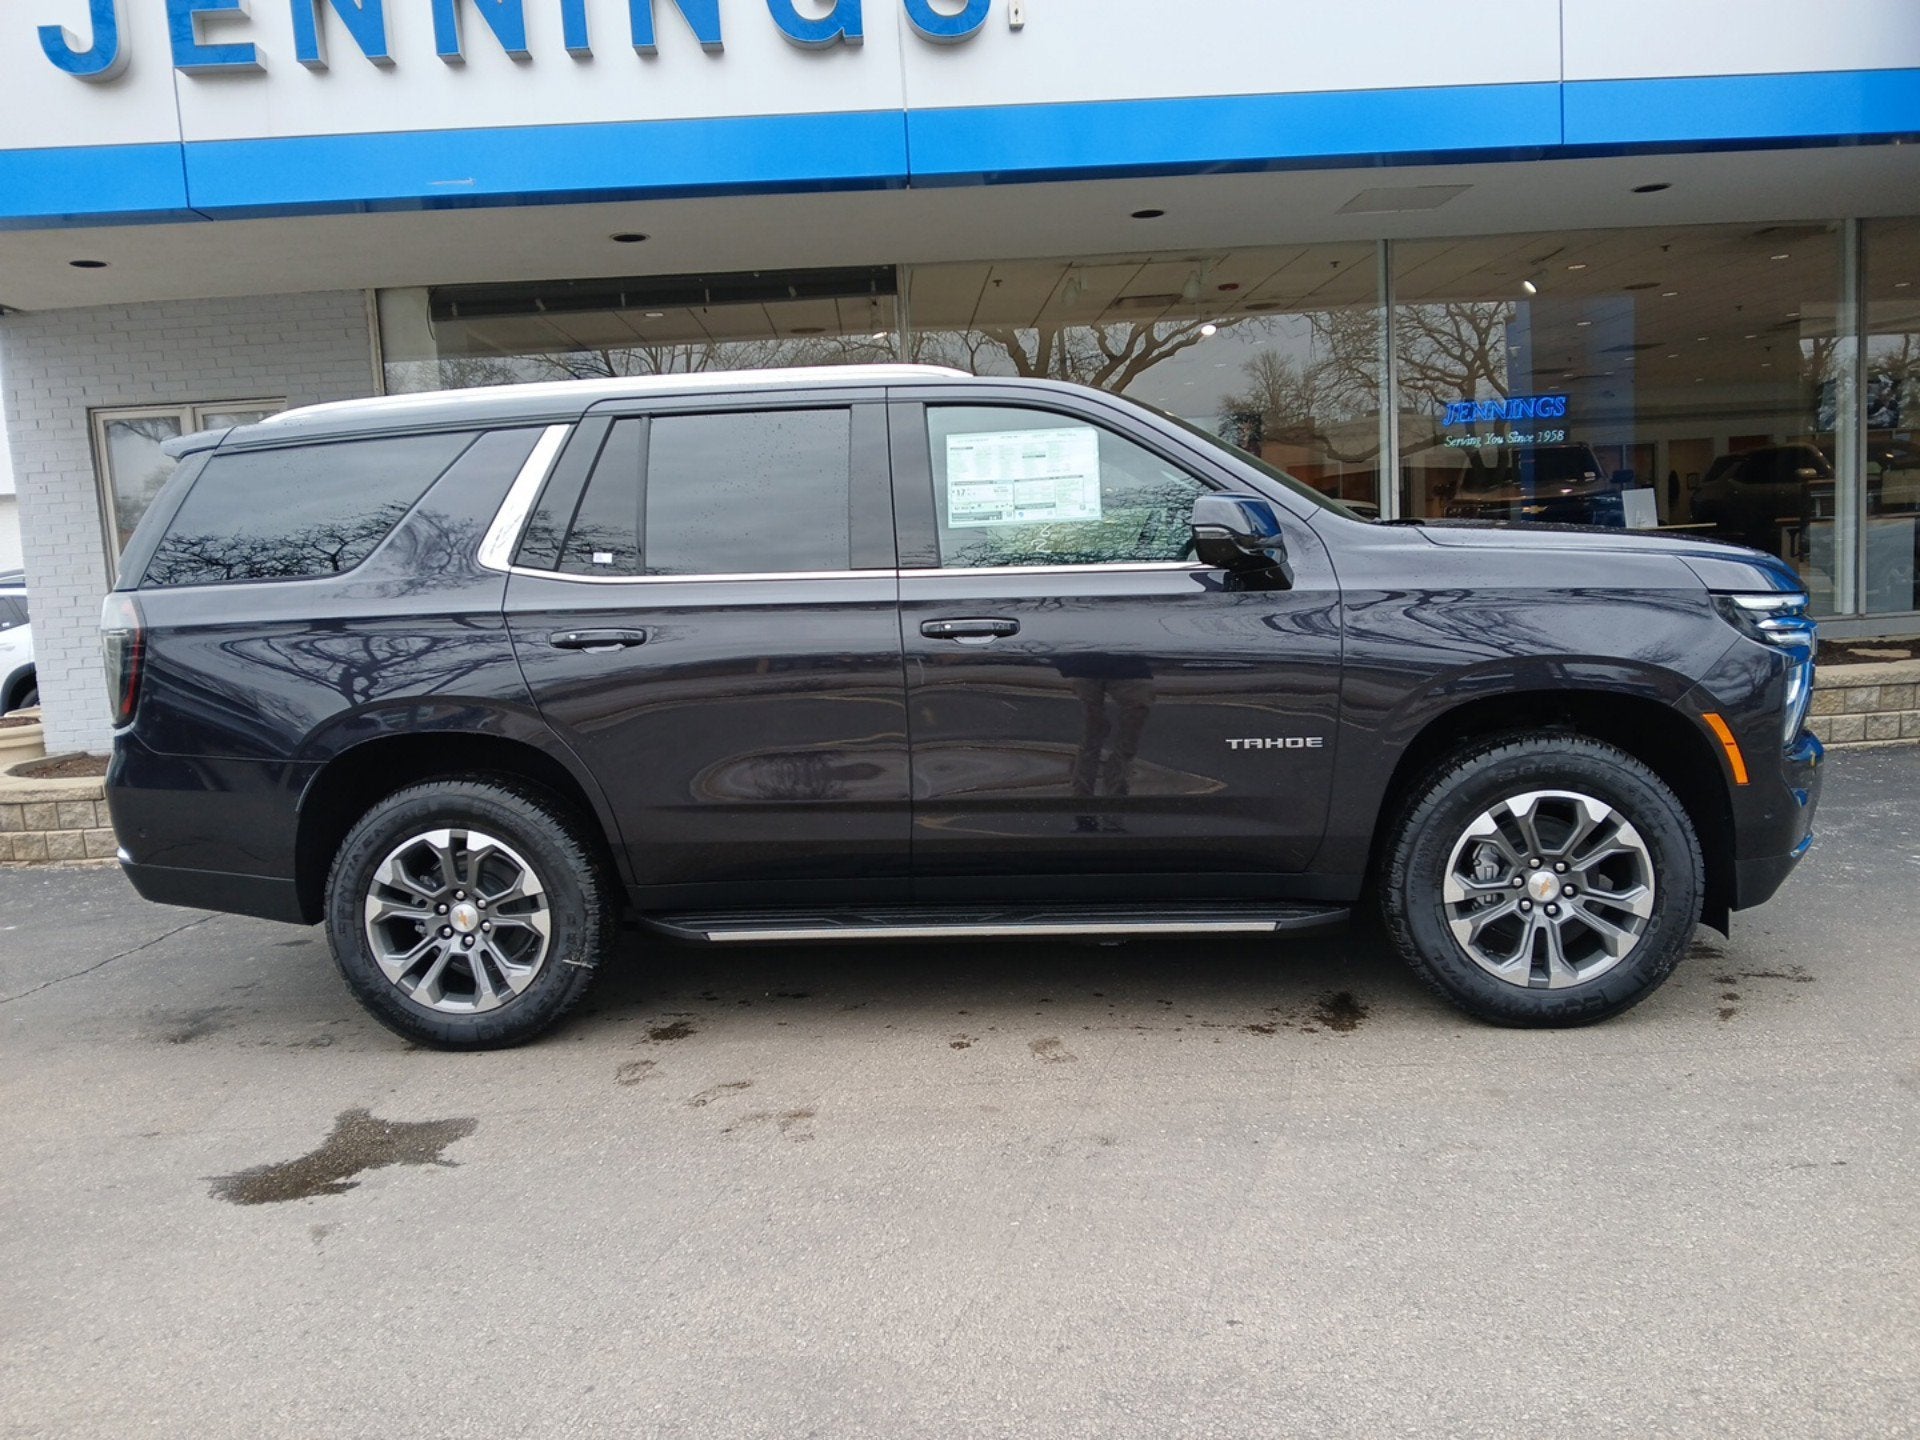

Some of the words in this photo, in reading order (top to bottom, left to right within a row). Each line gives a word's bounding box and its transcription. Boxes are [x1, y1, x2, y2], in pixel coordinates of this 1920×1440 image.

[1443, 396, 1567, 426] JENNINGS
[1444, 433, 1482, 448] Serving
[1485, 432, 1504, 445] You
[1506, 431, 1534, 444] Since
[1537, 429, 1565, 443] 1958
[1225, 737, 1323, 750] TAHOE
